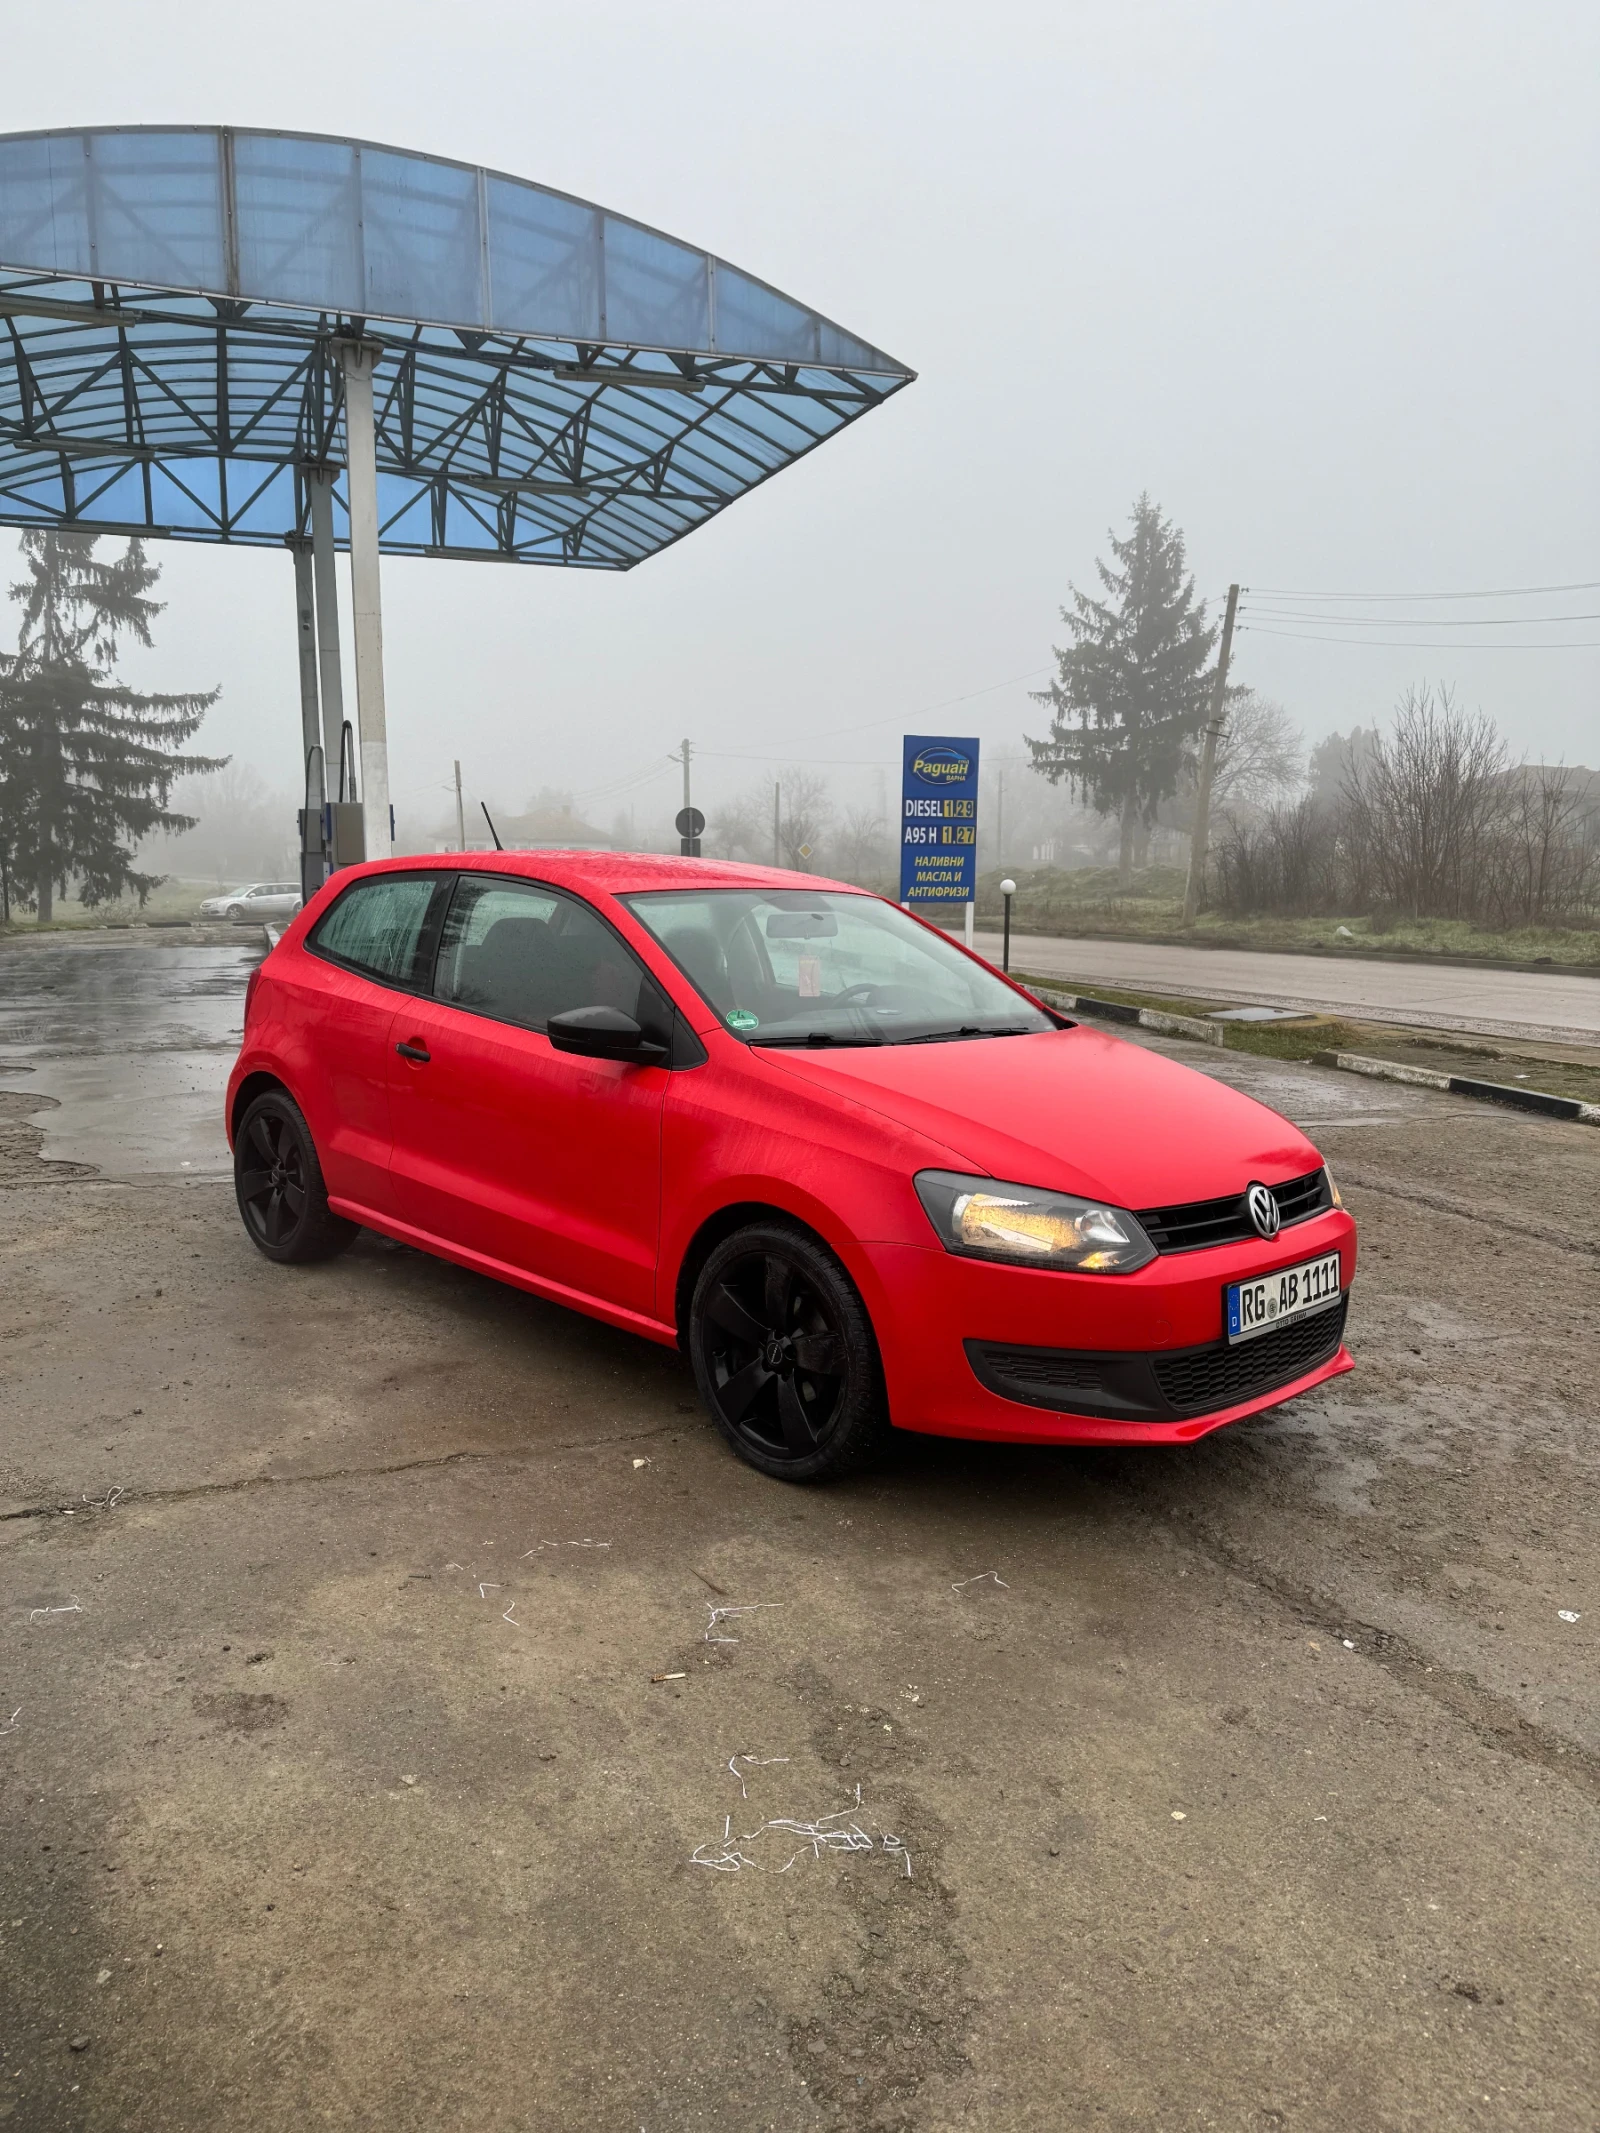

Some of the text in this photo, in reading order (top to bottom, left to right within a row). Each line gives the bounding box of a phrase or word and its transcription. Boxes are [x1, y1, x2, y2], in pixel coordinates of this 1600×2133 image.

[905, 800, 973, 817] DIESEL 1.29
[904, 826, 926, 844] A95
[943, 827, 974, 844] 1.27
[914, 856, 965, 867] НАЛИВНИ
[916, 871, 962, 882] МАСЛА И
[907, 886, 969, 897] АНТИФРИЗИ
[1242, 1259, 1339, 1326] RG AB 1111
[1231, 1316, 1238, 1327] D
